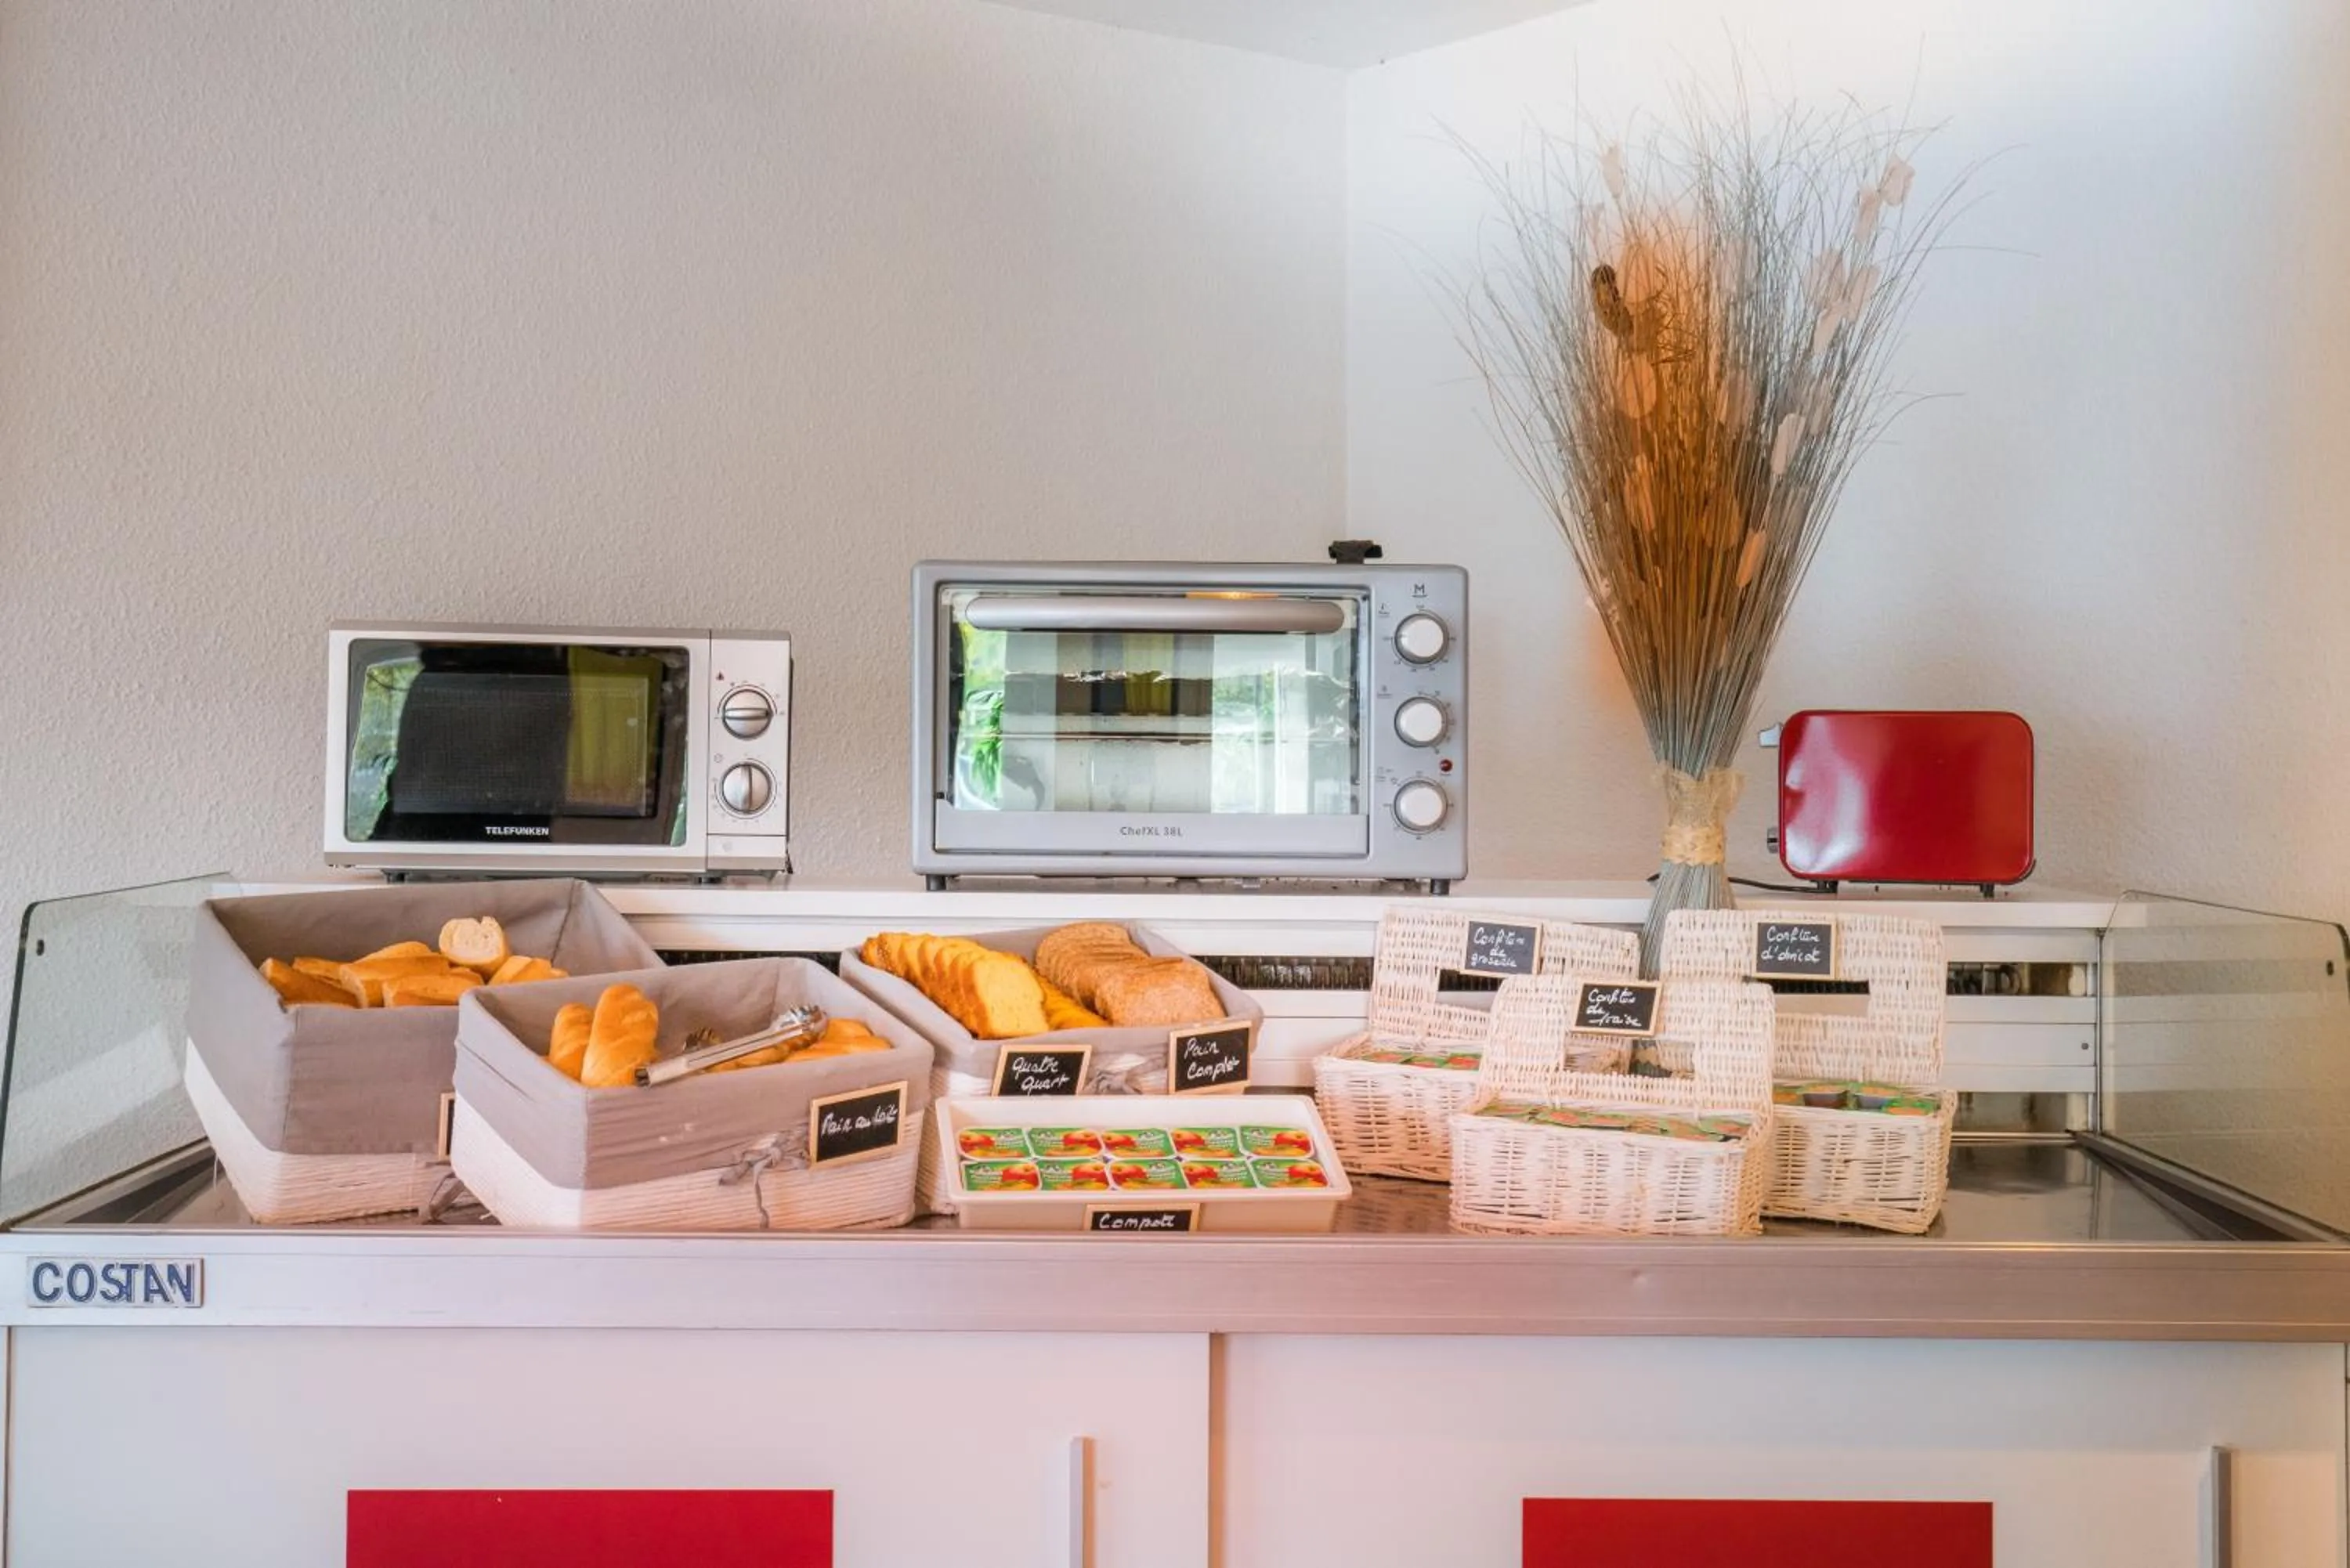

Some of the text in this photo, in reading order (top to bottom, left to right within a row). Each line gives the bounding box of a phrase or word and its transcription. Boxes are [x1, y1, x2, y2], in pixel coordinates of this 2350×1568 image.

[485, 826, 549, 836] TELEFUNKEN
[1163, 826, 1183, 836] 38L
[1184, 1037, 1220, 1059] Pain
[821, 1112, 852, 1135] Pain
[32, 1262, 193, 1303] COSTAN
